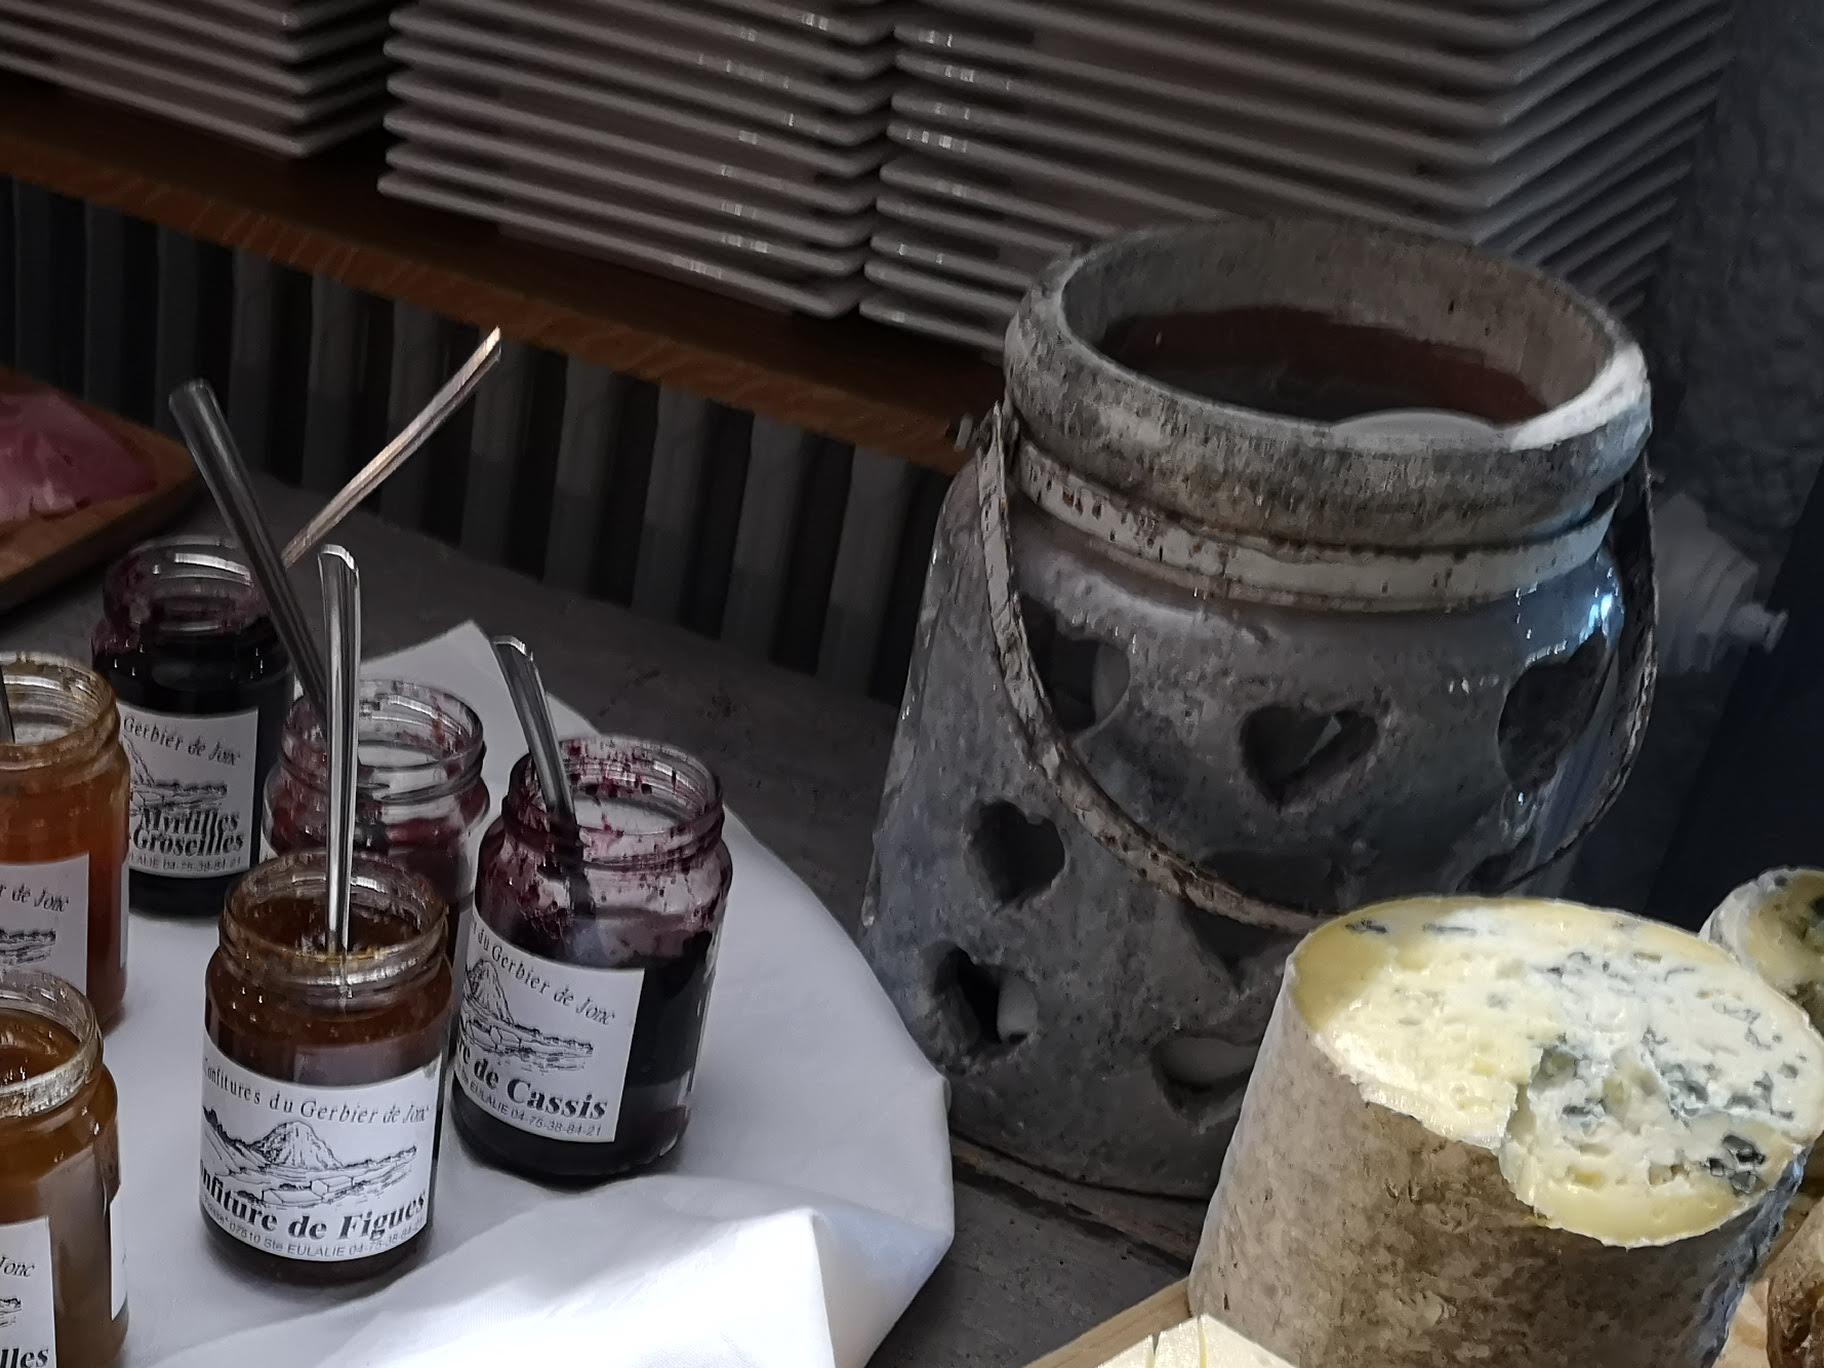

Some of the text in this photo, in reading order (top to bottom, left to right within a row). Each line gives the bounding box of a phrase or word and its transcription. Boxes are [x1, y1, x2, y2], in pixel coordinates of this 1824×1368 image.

[123, 715, 184, 748] Gerbier
[188, 735, 206, 757] de
[139, 807, 241, 835] Myrtilles
[133, 826, 244, 857] Groseilles
[11, 882, 31, 904] de
[478, 928, 490, 951] du
[491, 945, 551, 995] Gerbier
[553, 984, 574, 1008] de
[575, 997, 615, 1026] Jonc
[473, 1058, 499, 1091] de
[506, 1076, 608, 1121] Cassis
[269, 1092, 293, 1114] du
[300, 1099, 379, 1124] Gerbier
[383, 1104, 401, 1124] de
[288, 1214, 327, 1241] de
[338, 1189, 427, 1241] Figues
[287, 1243, 345, 1258] EULALIE
